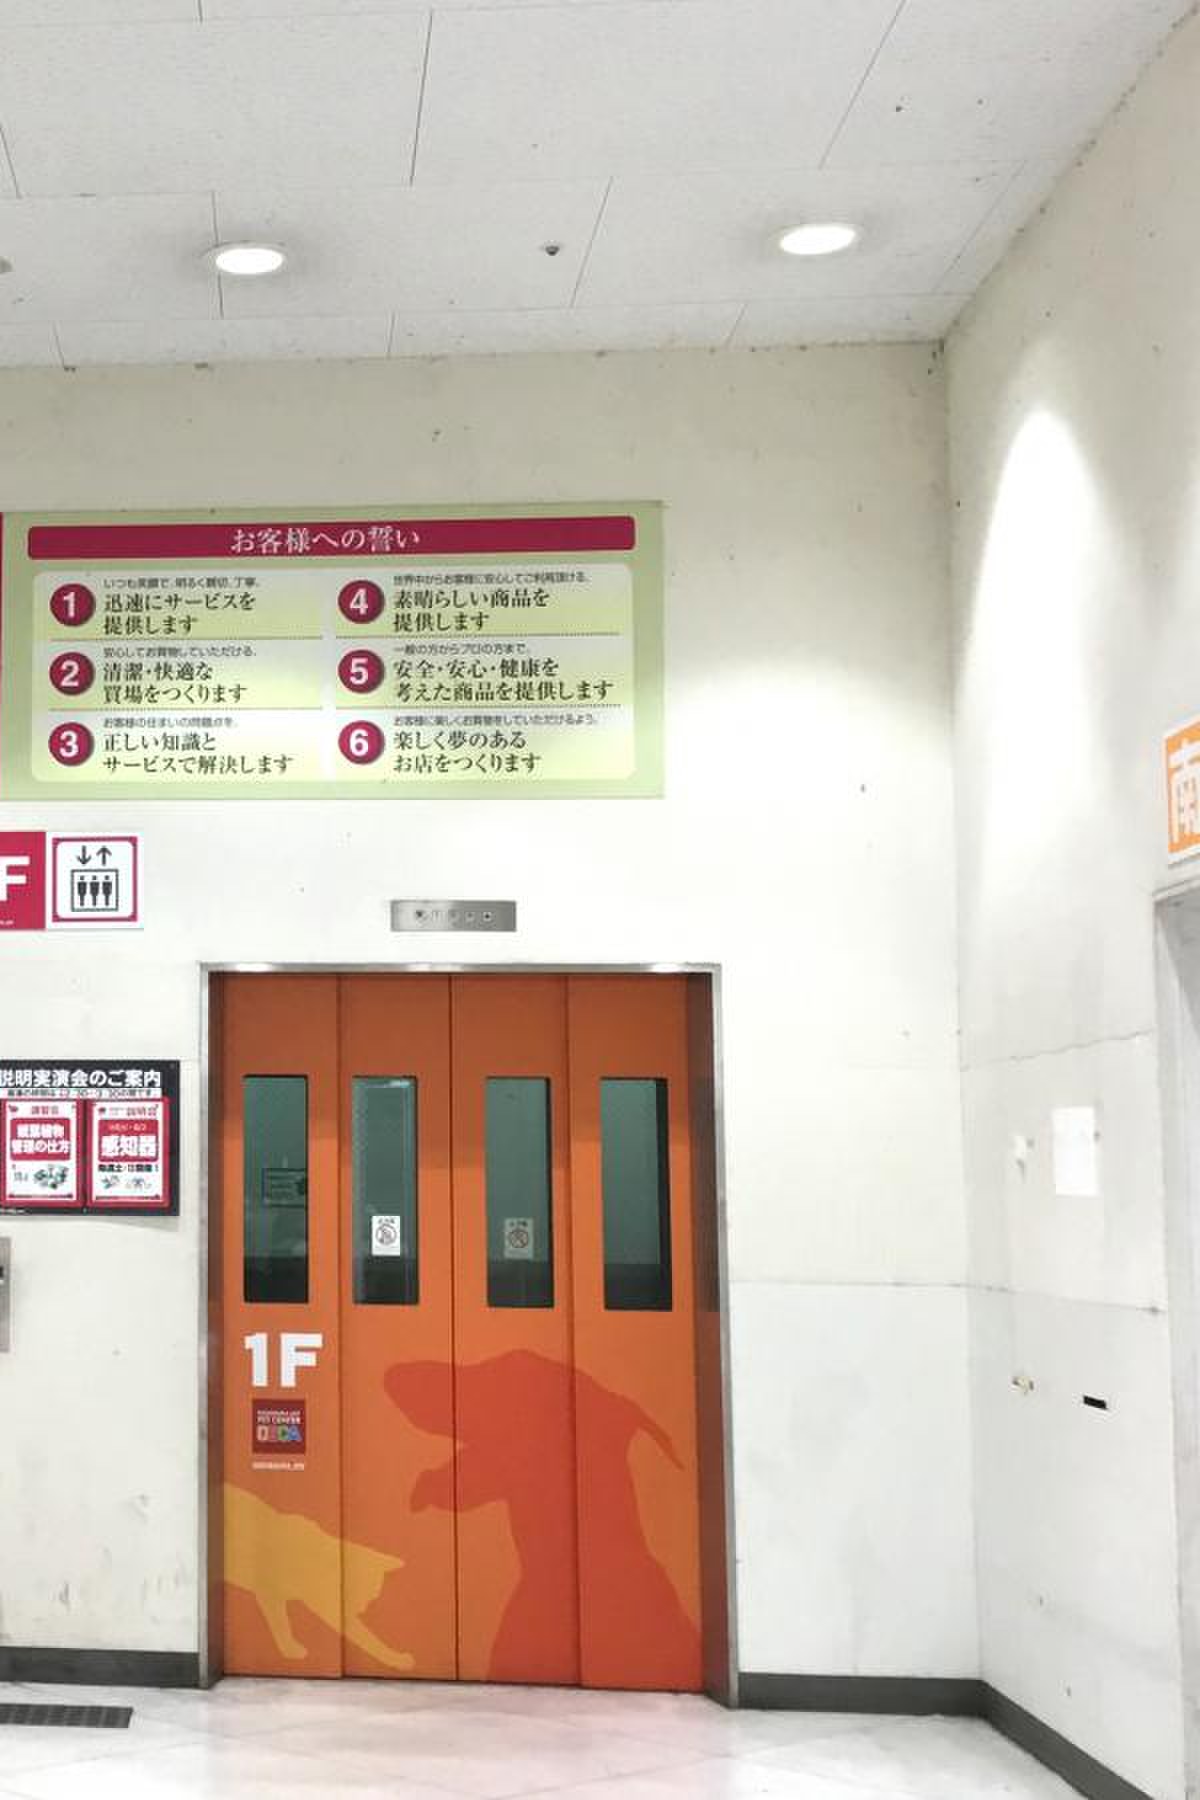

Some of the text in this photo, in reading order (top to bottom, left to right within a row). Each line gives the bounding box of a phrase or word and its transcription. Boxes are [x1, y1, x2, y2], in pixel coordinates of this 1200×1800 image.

[230, 525, 420, 554] お客様への誓い
[103, 591, 256, 612] 迅速にサービスを
[349, 588, 369, 614] 4
[394, 587, 550, 610] 素晴らしい商品を
[103, 615, 198, 636] 提供します
[393, 611, 490, 633] 提供します
[60, 661, 80, 687] 2
[103, 661, 213, 681] 清潔・快適な
[350, 658, 369, 685] 5
[394, 657, 560, 680] 安全・安心・健康を
[103, 684, 247, 704] 買場をつくります
[394, 680, 614, 703] 考えた商品を提供します
[59, 730, 79, 758] 3
[103, 731, 216, 752] 正しい知識と
[349, 729, 369, 756] 6
[394, 730, 527, 751] 楽しく夢のある
[102, 754, 294, 776] サービスで解決します
[393, 751, 542, 775] お店をつくります
[244, 1331, 323, 1388] 1F
